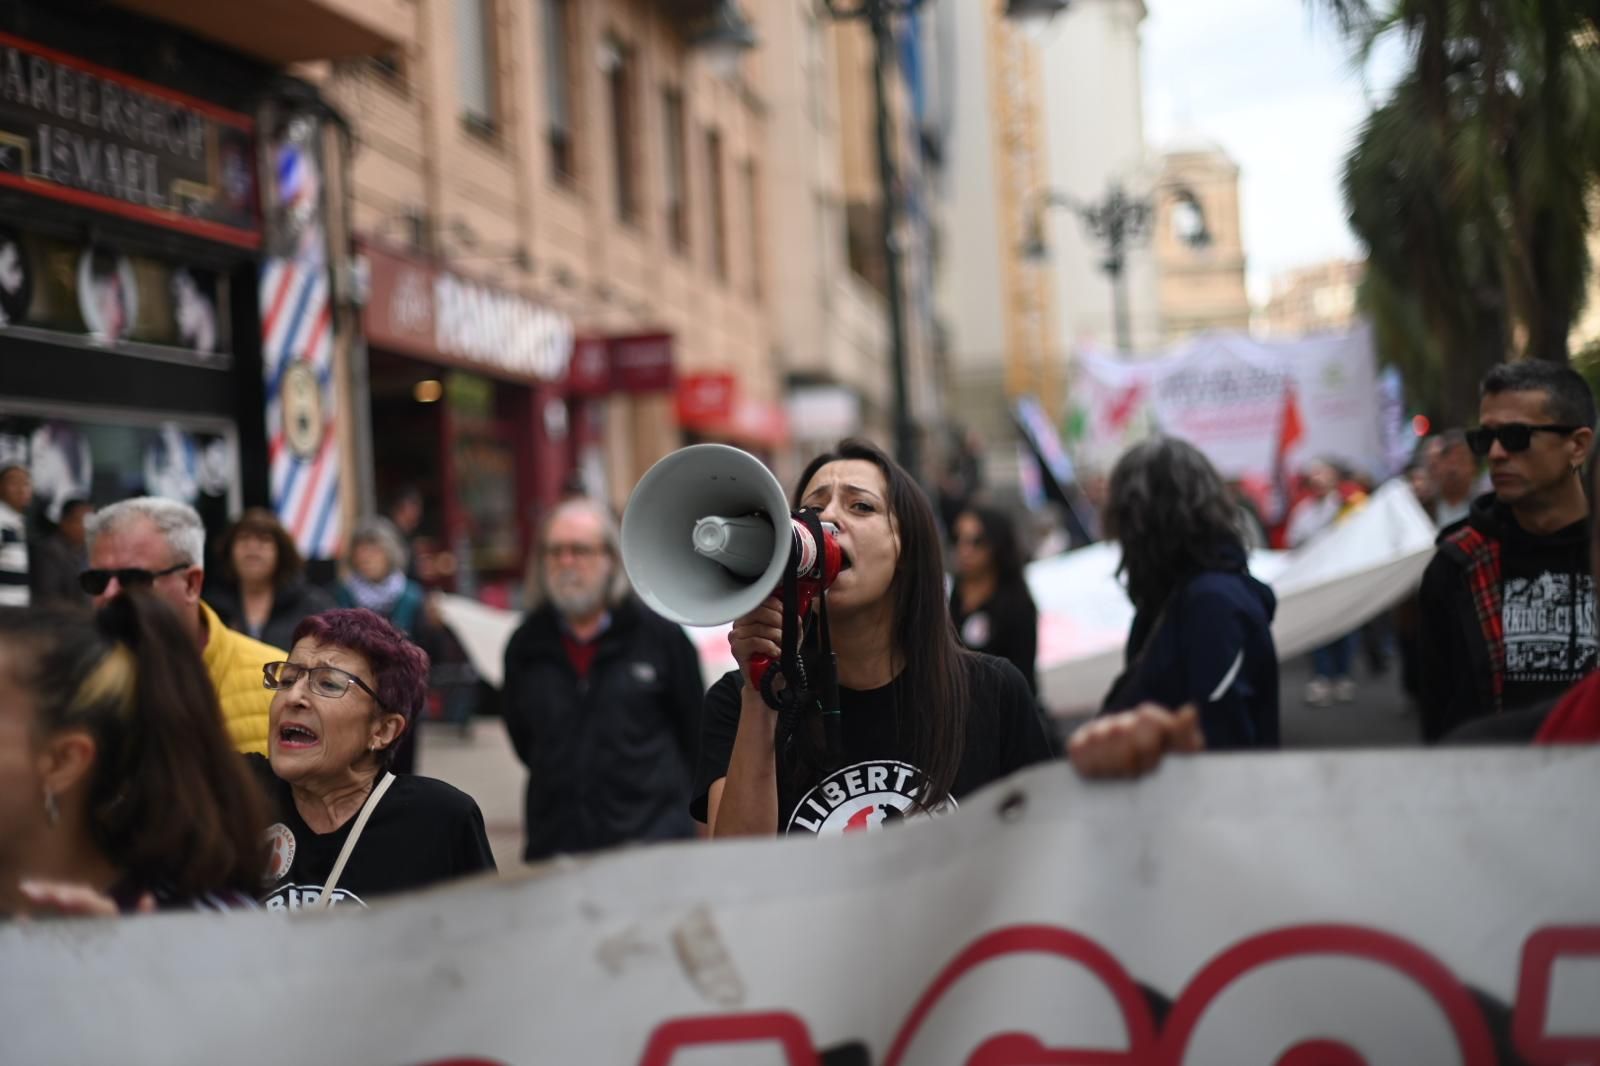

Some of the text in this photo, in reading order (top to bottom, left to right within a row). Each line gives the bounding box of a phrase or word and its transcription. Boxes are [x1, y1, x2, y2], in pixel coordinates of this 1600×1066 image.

[0, 47, 207, 160] ARBERSHOP
[38, 123, 168, 210] ISMAEL
[1502, 601, 1598, 636] RKING CLAS
[795, 766, 927, 833] LIBERT
